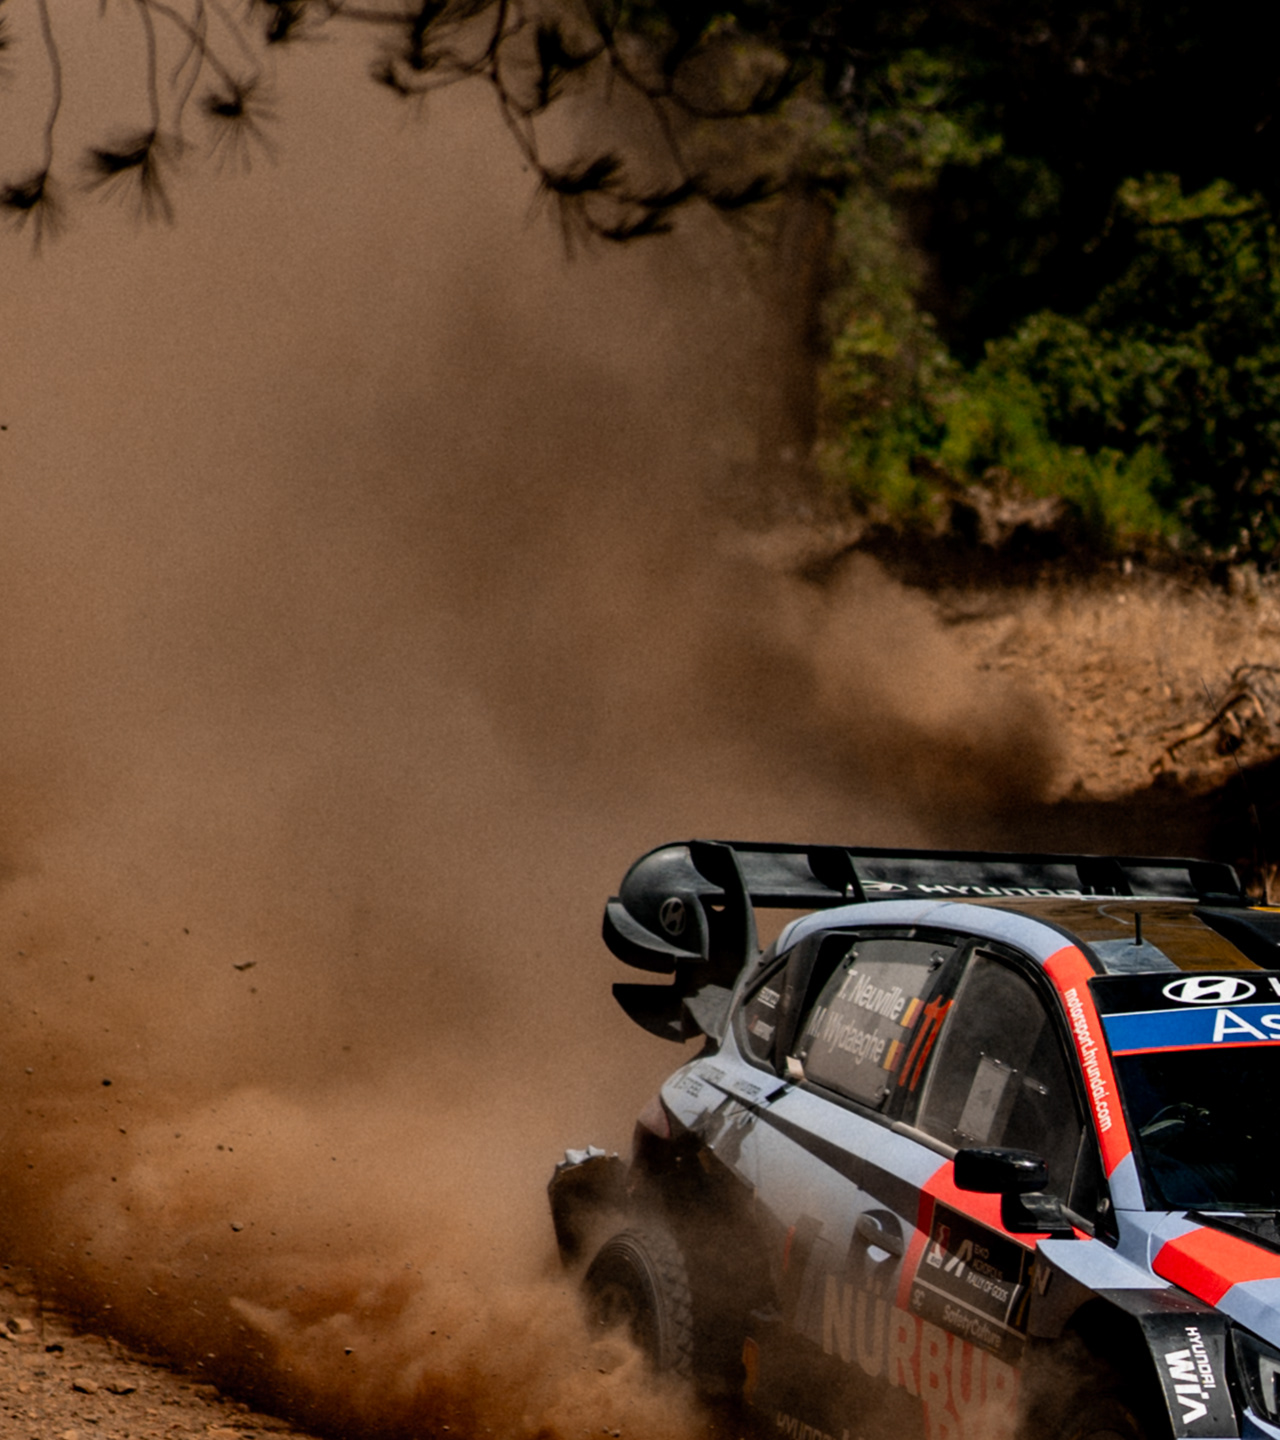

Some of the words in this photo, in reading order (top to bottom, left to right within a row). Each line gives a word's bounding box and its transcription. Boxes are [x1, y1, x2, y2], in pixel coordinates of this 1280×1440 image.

[847, 973, 906, 1021] Neuville
[822, 1009, 886, 1065] Wydaeghe
[898, 993, 954, 1093] 11
[1064, 987, 1113, 1133] motorsport.hyundai.com
[1164, 1348, 1210, 1425] WIA
[1184, 1327, 1217, 1389] HYUNDAI
